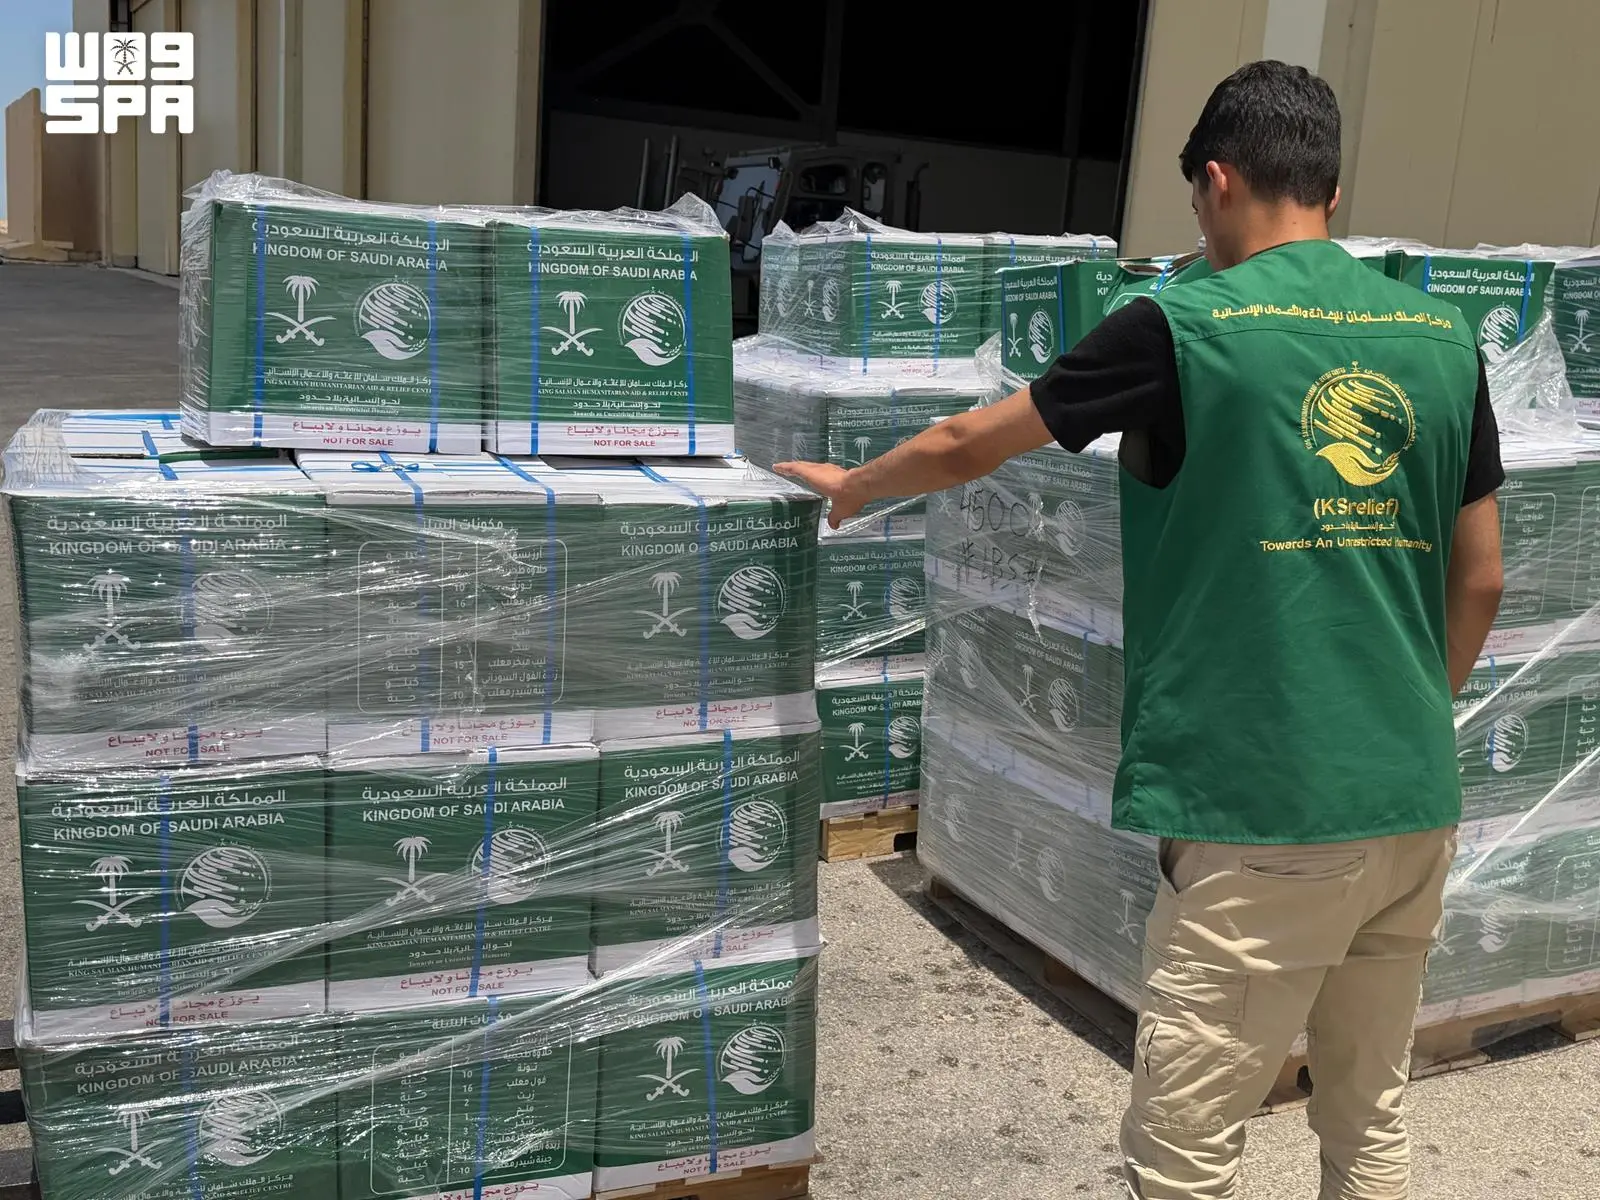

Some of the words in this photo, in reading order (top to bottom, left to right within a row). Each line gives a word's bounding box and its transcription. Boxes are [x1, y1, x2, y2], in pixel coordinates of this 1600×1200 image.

[334, 226, 386, 245] العربية
[327, 250, 345, 261] OF
[350, 251, 392, 265] SAUDI
[598, 244, 643, 261] العربية
[593, 265, 609, 276] OF
[613, 267, 649, 278] SAUDI
[1472, 268, 1501, 283] العربية
[1467, 285, 1478, 294] OF
[1480, 286, 1503, 295] SAUDI
[747, 516, 800, 531] المملكة
[621, 523, 690, 540] السعودية
[50, 541, 132, 555] KINGDOM
[224, 539, 285, 552] ARABIA
[622, 544, 684, 556] KINGDOM
[710, 540, 748, 552] SAUDI
[752, 537, 798, 550] ARABIA
[1260, 539, 1311, 551] Towards
[1315, 538, 1332, 548] An
[831, 565, 865, 573] KINGDOM
[455, 583, 465, 591] 10
[455, 661, 464, 669] 15
[833, 706, 866, 716] KINGDOM
[434, 736, 453, 744] NOT
[455, 735, 479, 744] FOR
[200, 744, 230, 753] SALE
[748, 751, 800, 766] المملكة
[506, 777, 567, 792] المملكة
[625, 782, 687, 798] KINGDOM
[692, 780, 709, 791] OF
[753, 771, 798, 785] ARABIA
[215, 790, 285, 806] المملكة
[362, 785, 442, 804] السعودية
[363, 807, 435, 822] KINGDOM
[440, 805, 459, 816] OF
[511, 799, 564, 812] ARABIA
[54, 824, 134, 840] KINGDOM
[140, 822, 161, 835] OF
[168, 817, 218, 833] SAUDI
[223, 812, 284, 828] ARABIA
[479, 982, 504, 991] SALE
[173, 1014, 195, 1023] FOR
[199, 1011, 228, 1020] SALE
[714, 1003, 752, 1016] SAUDI
[77, 1073, 154, 1094] KINGDOM
[239, 1055, 297, 1071] ARABIA
[518, 1063, 538, 1072] تونة
[723, 1160, 745, 1168] SALE
